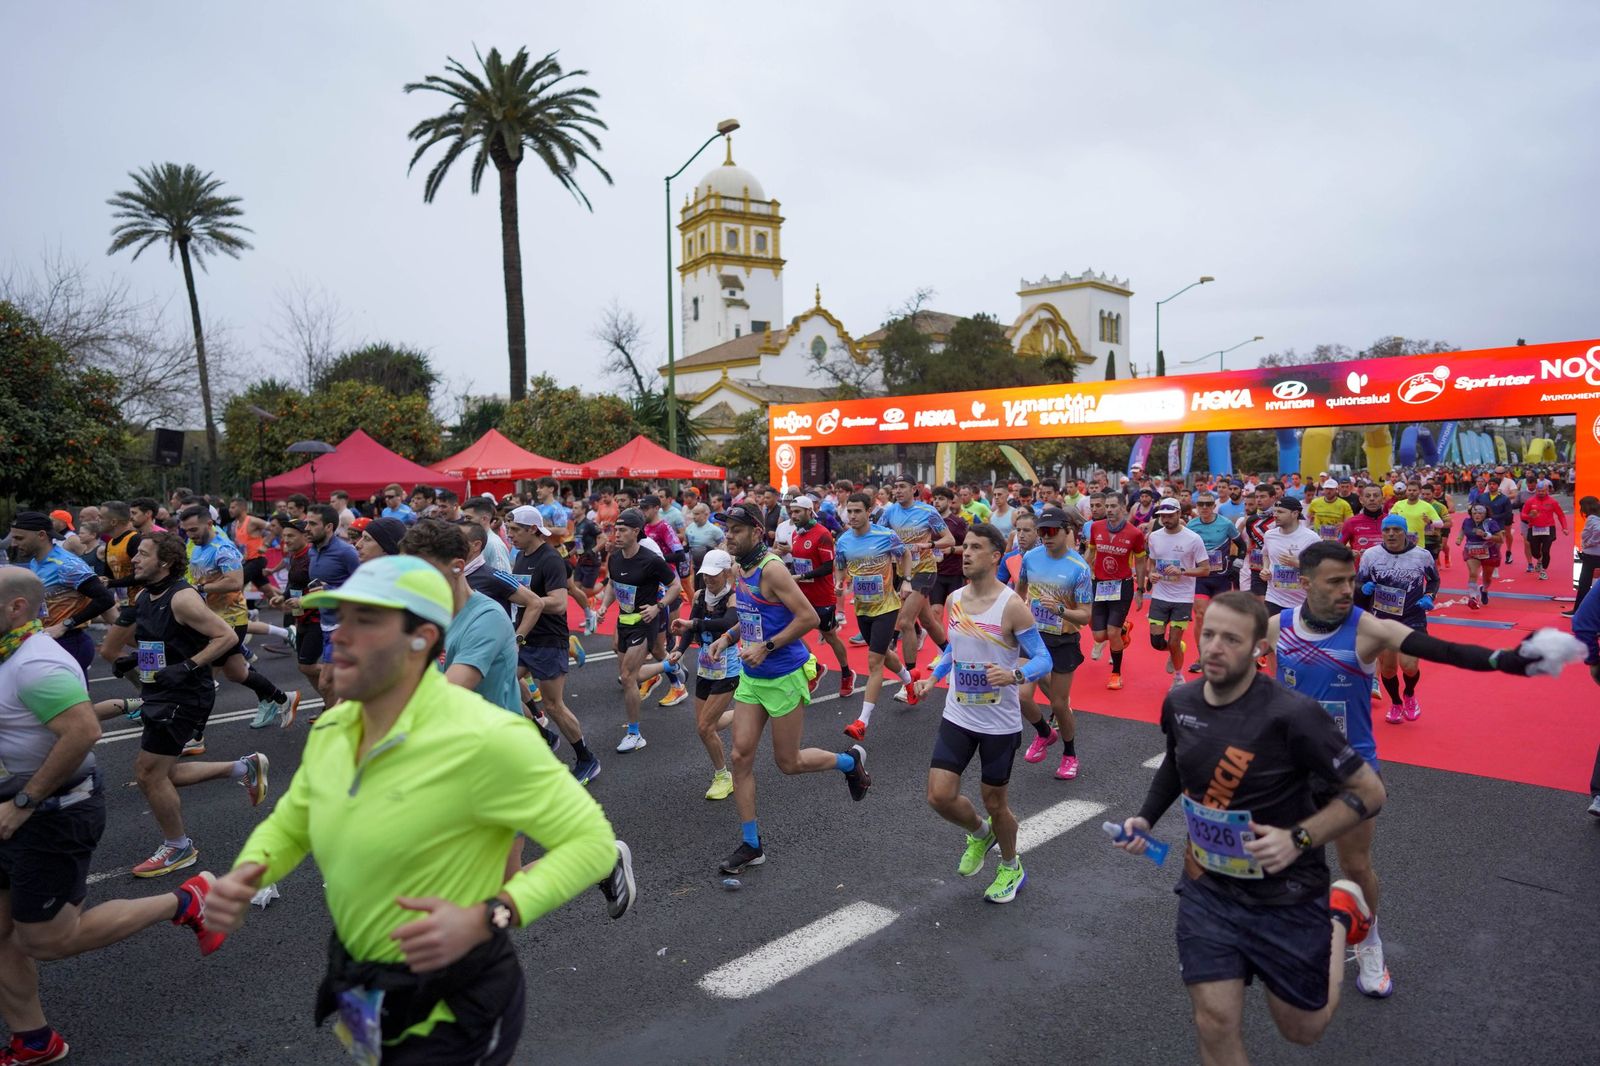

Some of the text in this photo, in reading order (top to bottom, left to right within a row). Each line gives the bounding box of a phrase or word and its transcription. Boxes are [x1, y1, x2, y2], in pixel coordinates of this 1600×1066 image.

[1454, 374, 1535, 391] Sprinter
[1191, 388, 1254, 411] HOKA
[1265, 399, 1314, 411] HYUNDAI
[914, 409, 957, 427] HOKA
[857, 582, 876, 592] 3670
[1034, 607, 1055, 621] 3112
[959, 672, 988, 687] 3098
